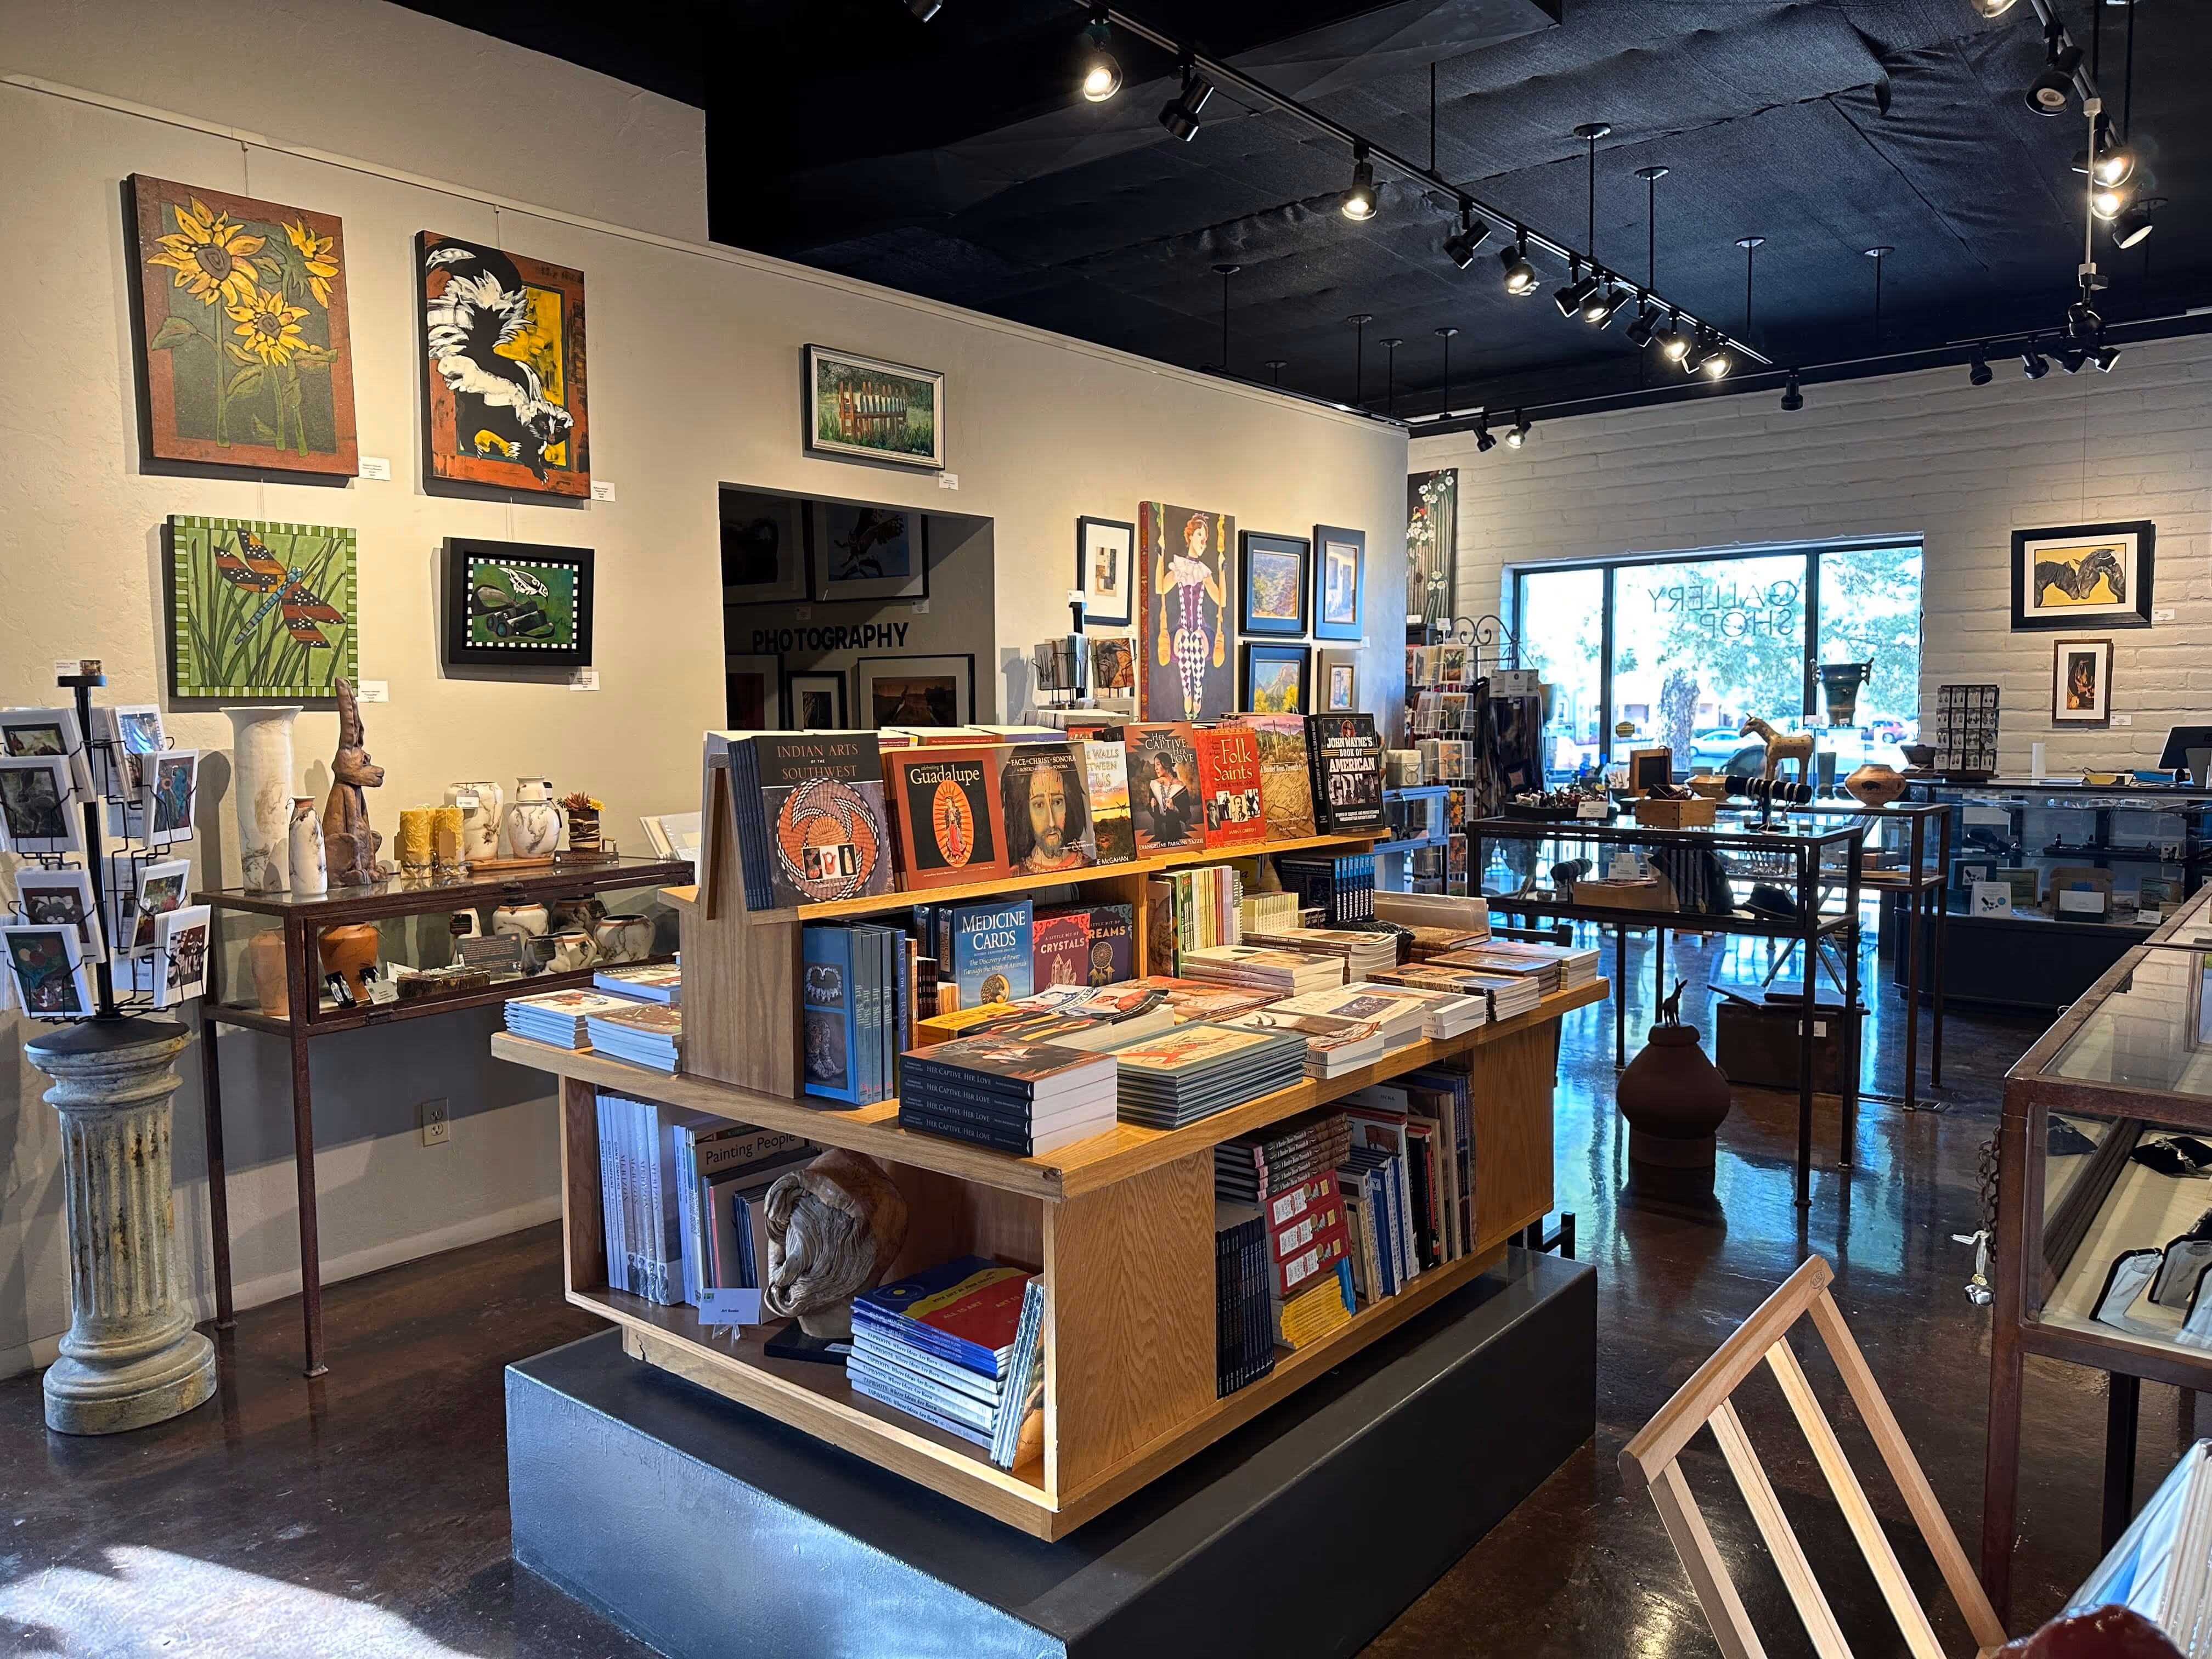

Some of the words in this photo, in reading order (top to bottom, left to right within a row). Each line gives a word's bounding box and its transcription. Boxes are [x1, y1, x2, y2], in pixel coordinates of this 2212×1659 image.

[753, 622, 909, 653] PHOTOGRAPHY
[777, 746, 824, 758] INDIAN
[829, 743, 859, 755] ARTS
[1221, 738, 1252, 764] Folk
[1327, 737, 1344, 748] JOHN
[1344, 736, 1373, 748] WAYNE'S
[1052, 755, 1076, 763] SONORA
[1092, 748, 1119, 758] WALLS
[782, 765, 857, 780] SOUTHWEST
[910, 764, 980, 786] Guadalupe
[1087, 761, 1117, 771] ETWEEN
[1213, 756, 1252, 781] Saints
[1329, 757, 1375, 773] AMERICAN
[1328, 772, 1379, 806] GRIT
[1139, 841, 1167, 850] EVANGELINE
[1102, 855, 1128, 865] McGAHAN
[962, 911, 1026, 933] MEDICINE
[1088, 925, 1126, 939] REAMS
[973, 930, 1016, 950] CARDS
[1040, 938, 1085, 954] CRYSTALS
[979, 956, 1001, 965] Discovery
[1009, 960, 1027, 968] Animals
[933, 1014, 975, 1024] THIN
[927, 1065, 938, 1074] HER
[964, 1073, 976, 1081] HER
[977, 1075, 991, 1085] LOVE
[927, 1083, 938, 1092] HER
[963, 1091, 975, 1100] HER
[975, 1094, 990, 1104] LOVE
[927, 1101, 938, 1110] HER
[963, 1109, 975, 1118] HER
[975, 1112, 990, 1122] LOVE
[926, 1119, 938, 1128] HER
[963, 1127, 975, 1137] HER
[976, 1131, 990, 1141] LOVE
[706, 1143, 753, 1165] Painting
[757, 1133, 795, 1150] People
[893, 1342, 906, 1353] Where
[906, 1347, 918, 1357] Ideas
[927, 1356, 938, 1365] Born
[895, 1354, 908, 1365] Where
[909, 1359, 920, 1369] Ideas
[929, 1369, 940, 1379] Born
[891, 1365, 904, 1376] Where
[905, 1371, 916, 1381] Ideas
[924, 1381, 935, 1391] Born
[888, 1376, 901, 1387] Where
[901, 1381, 913, 1392] Ideas
[922, 1391, 933, 1401] Born
[890, 1387, 904, 1398] Where
[904, 1393, 916, 1404] Ideas
[925, 1403, 937, 1412] Born
[893, 1398, 906, 1409] Where
[907, 1404, 918, 1415] Ideas
[927, 1414, 938, 1424] Born
